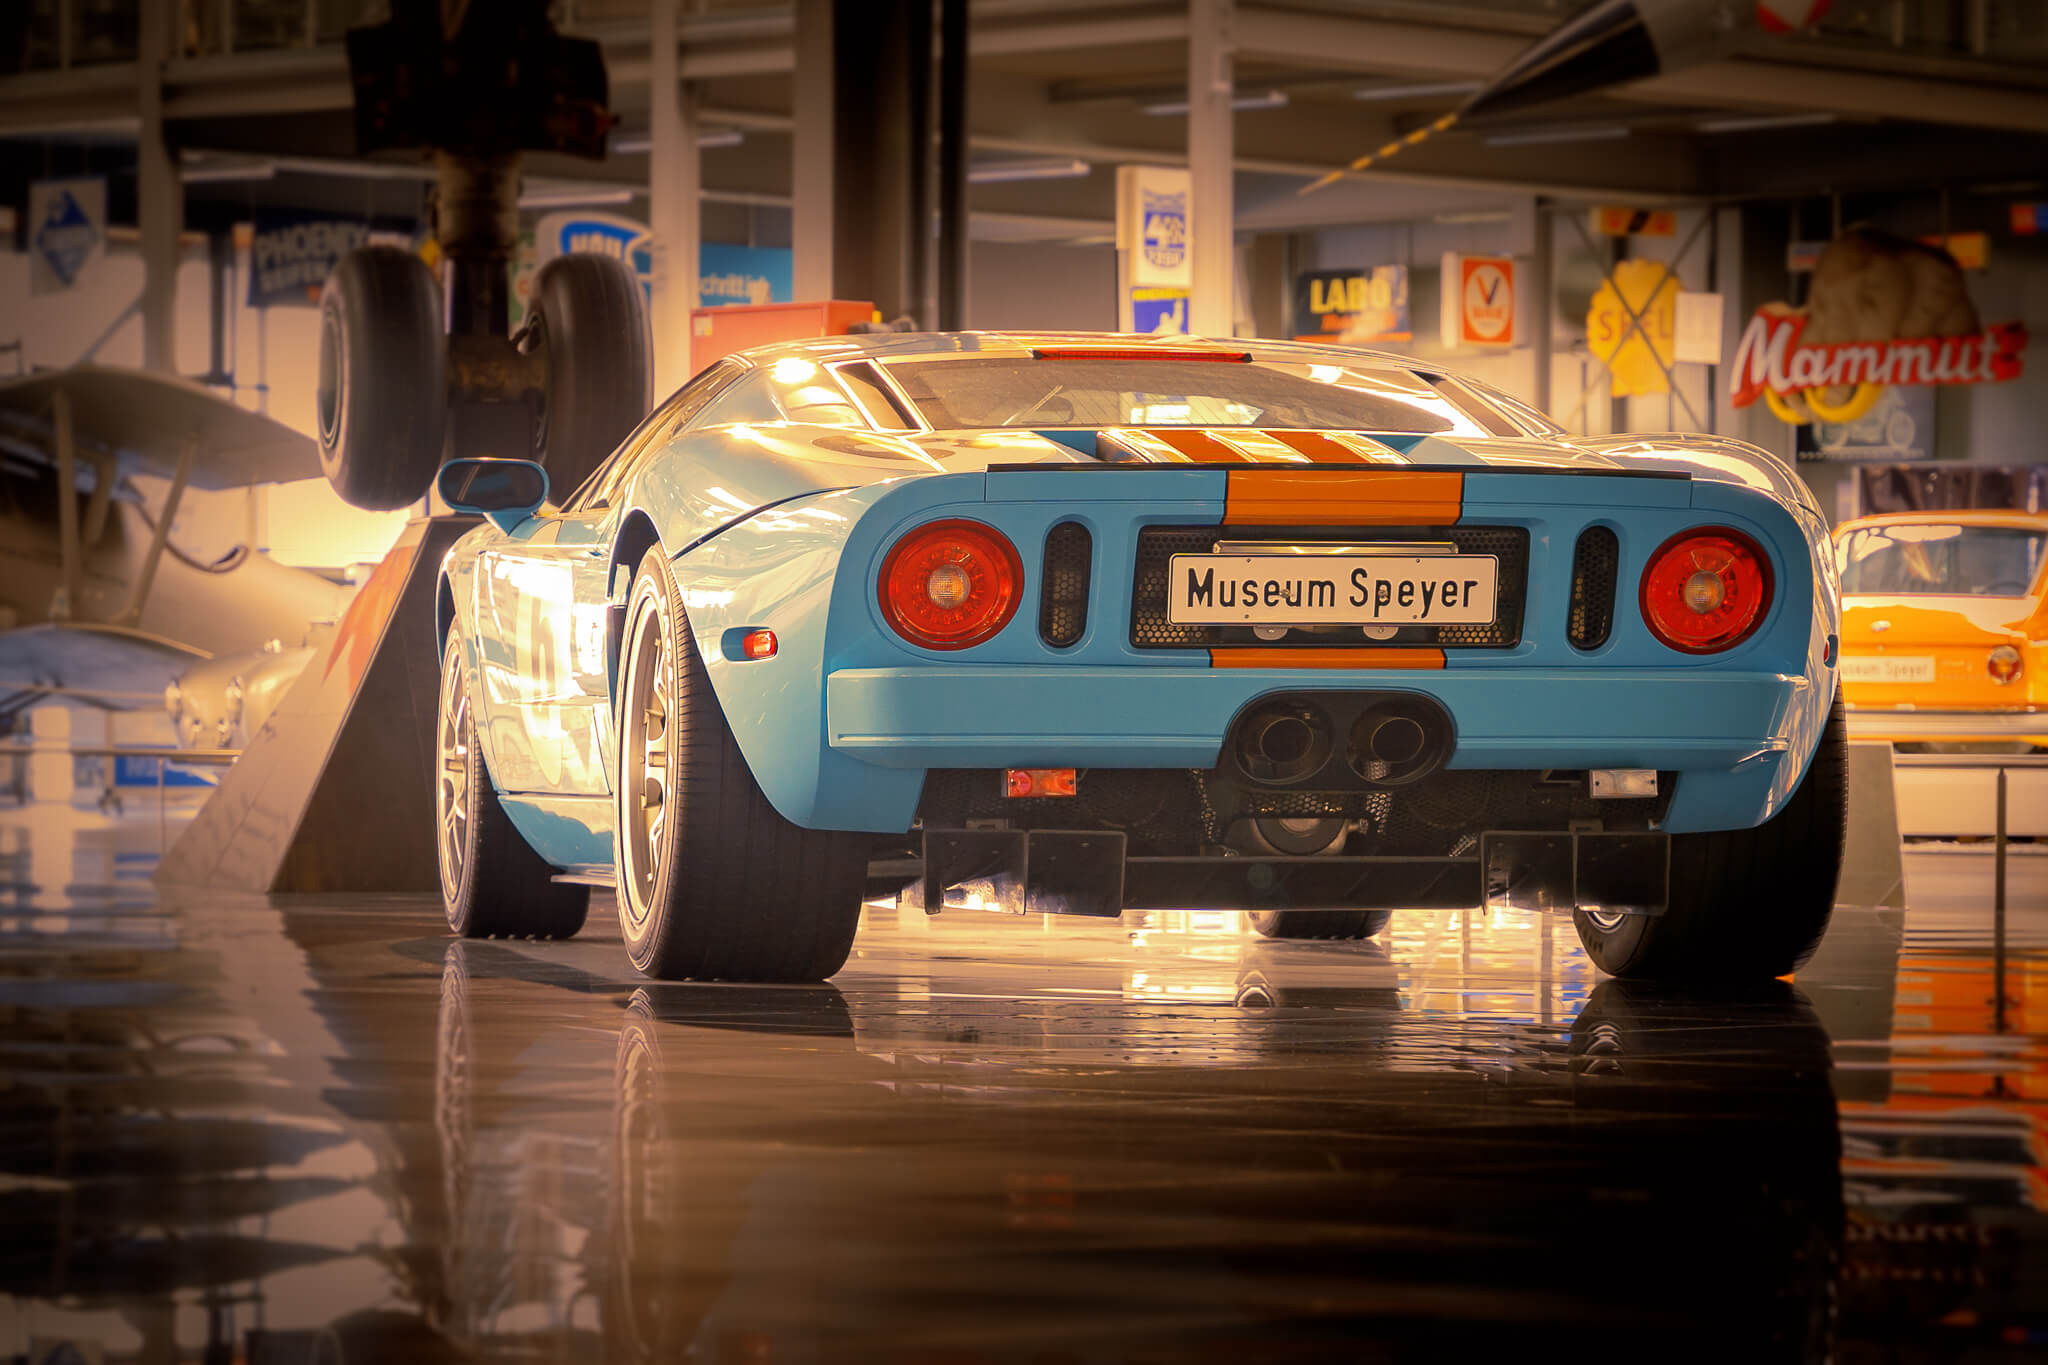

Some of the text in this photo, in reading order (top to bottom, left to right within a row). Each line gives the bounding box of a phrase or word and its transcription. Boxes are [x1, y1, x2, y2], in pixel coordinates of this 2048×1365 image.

[1730, 314, 1999, 394] Mammut
[1187, 567, 1479, 619] Museum Speyer
